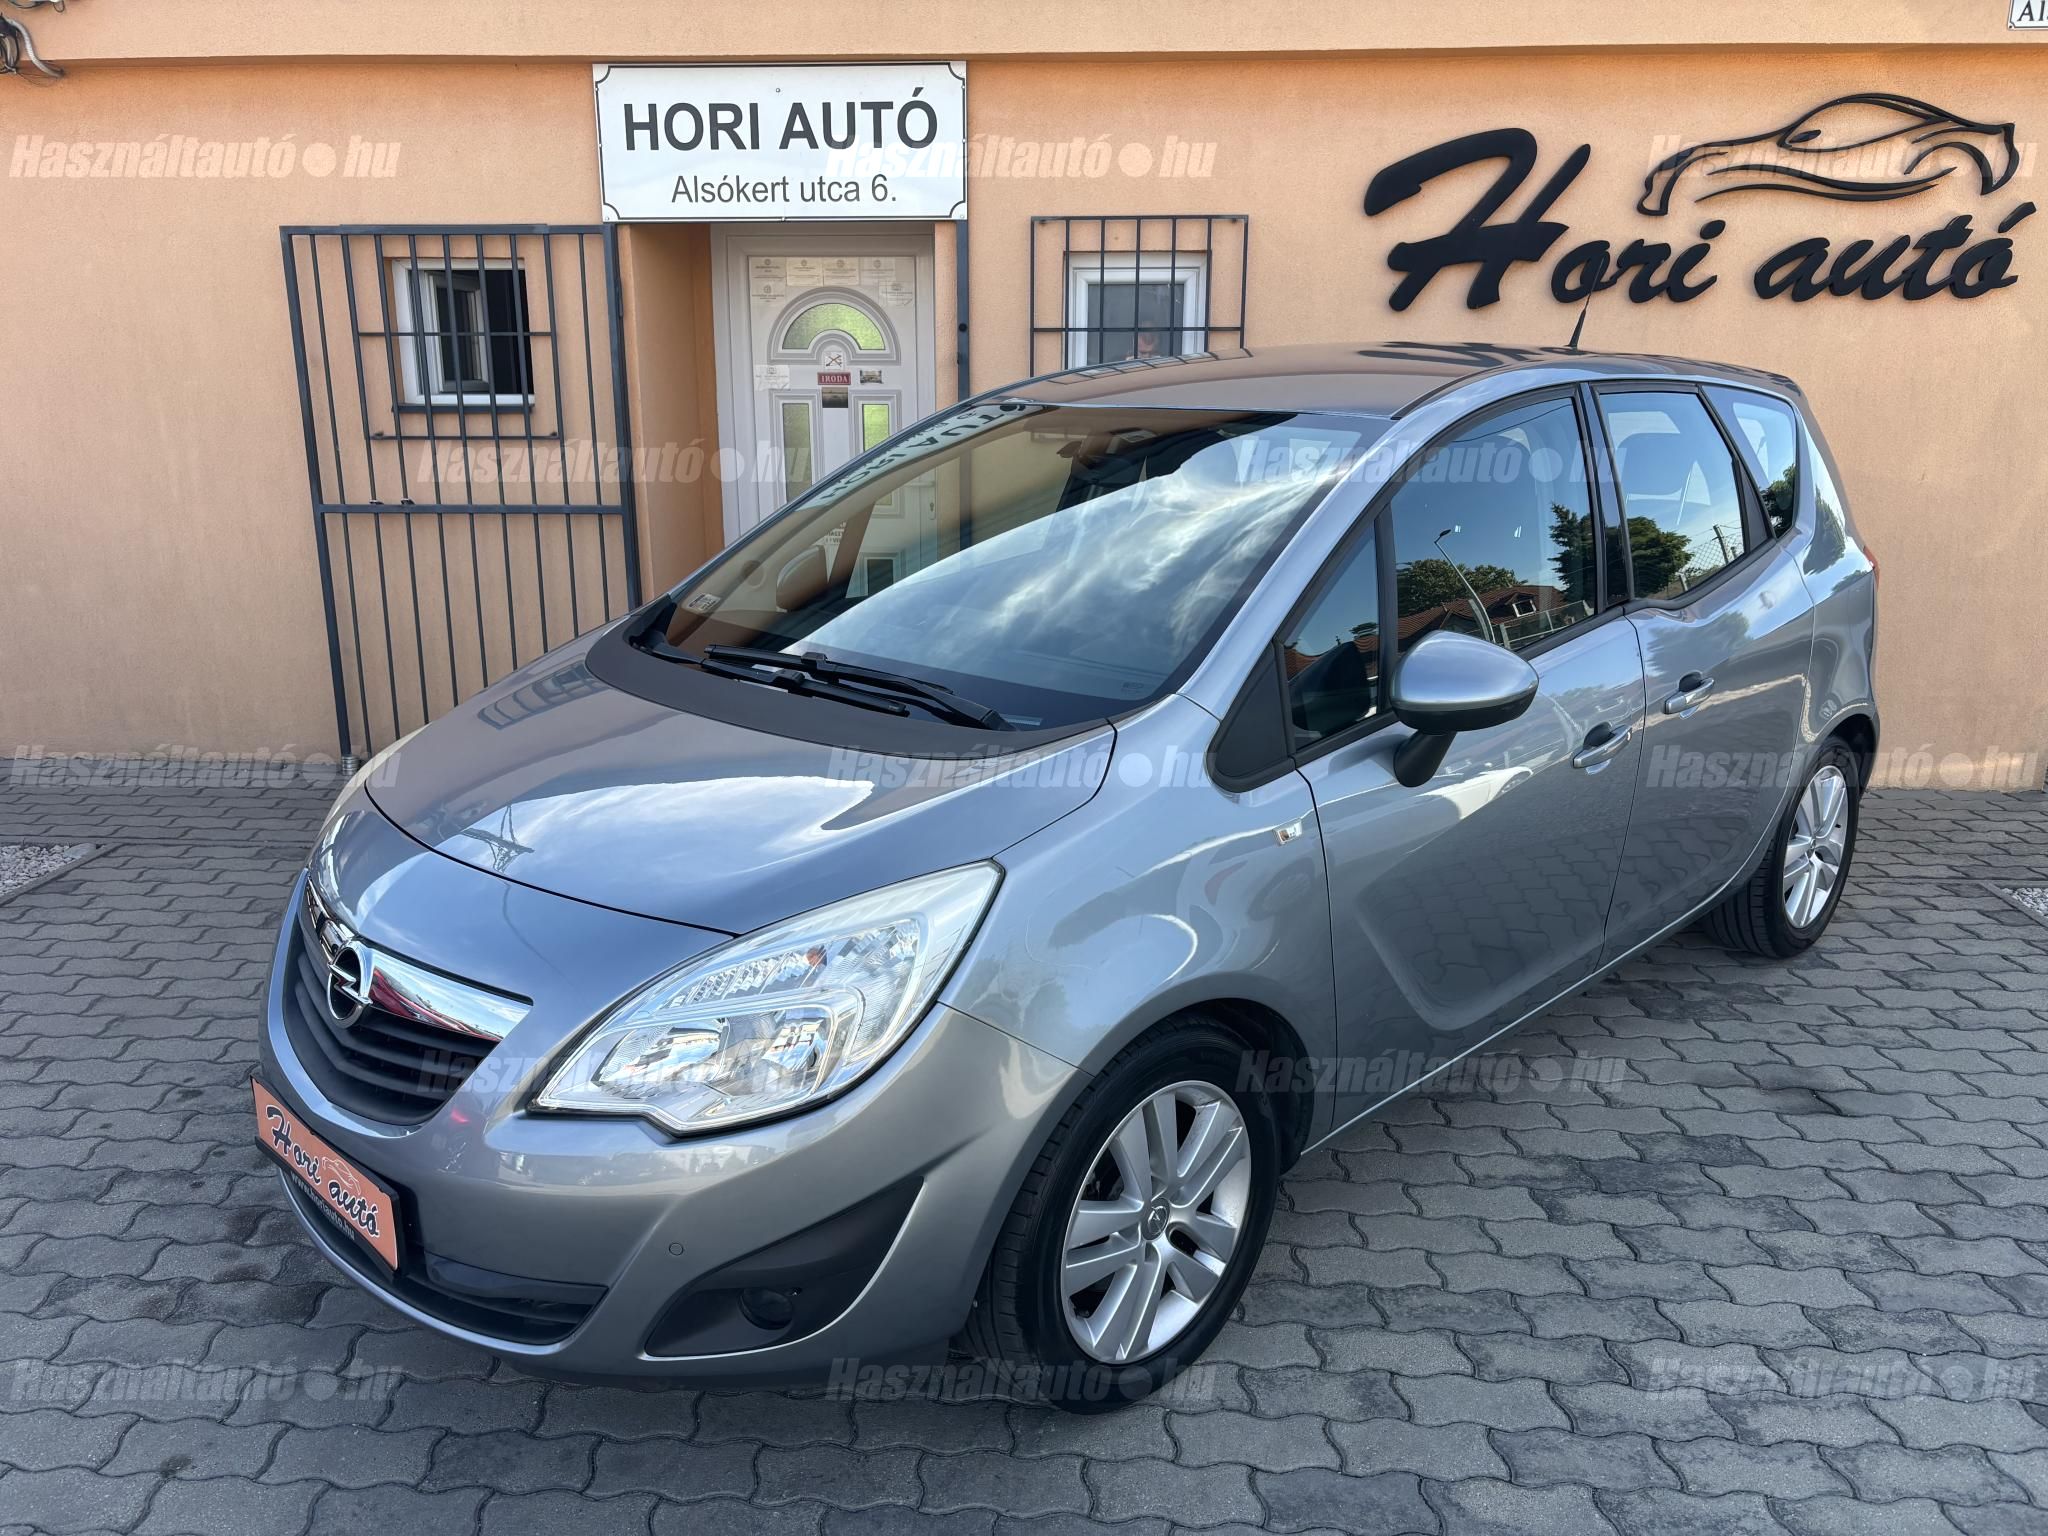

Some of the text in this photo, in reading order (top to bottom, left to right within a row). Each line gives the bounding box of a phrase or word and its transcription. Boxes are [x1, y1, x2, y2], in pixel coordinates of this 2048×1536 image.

[2017, 0, 2048, 21] Al
[623, 87, 938, 150] HORI AUTÓ
[671, 174, 896, 203] Alsókert utca 6.
[1364, 128, 2036, 311] Hori autó
[821, 375, 848, 383] IRODA
[266, 1105, 380, 1238] Hori autó
